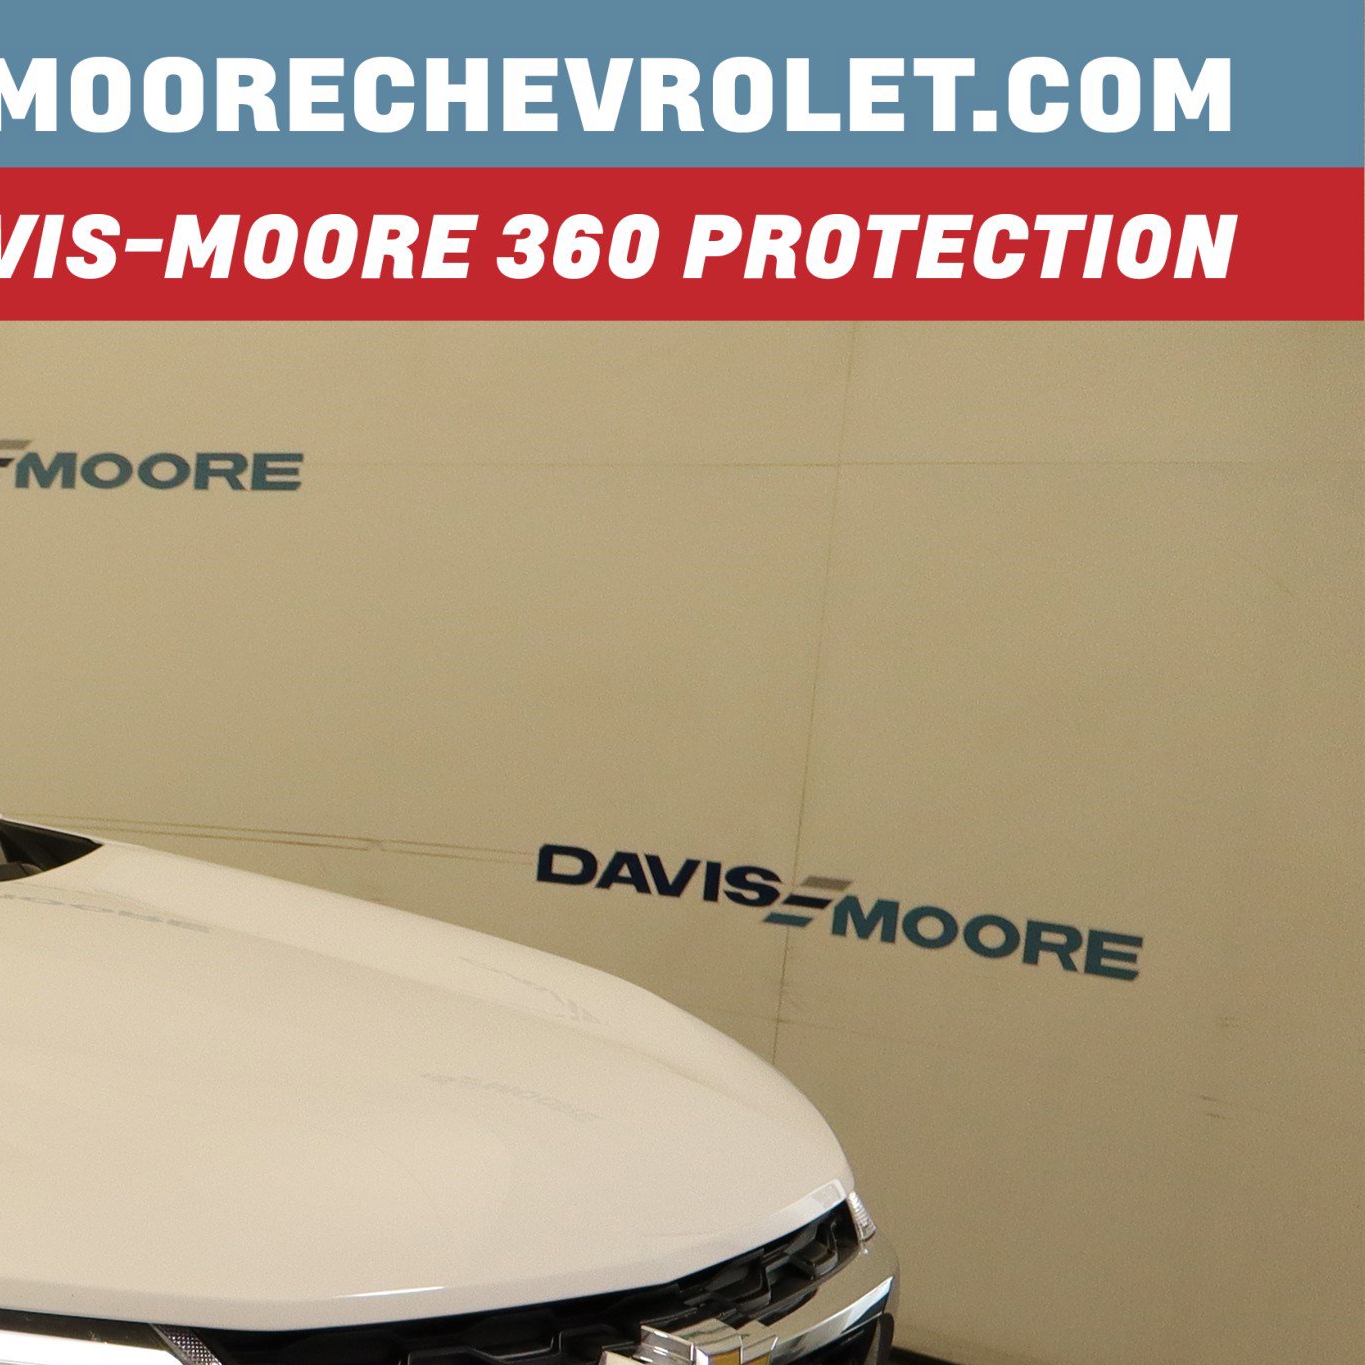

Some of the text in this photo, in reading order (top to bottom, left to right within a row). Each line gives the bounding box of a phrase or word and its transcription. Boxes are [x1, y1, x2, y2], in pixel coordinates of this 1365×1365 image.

[15, 452, 304, 490] MOORE
[536, 843, 1144, 982] DAVIS MOORE
